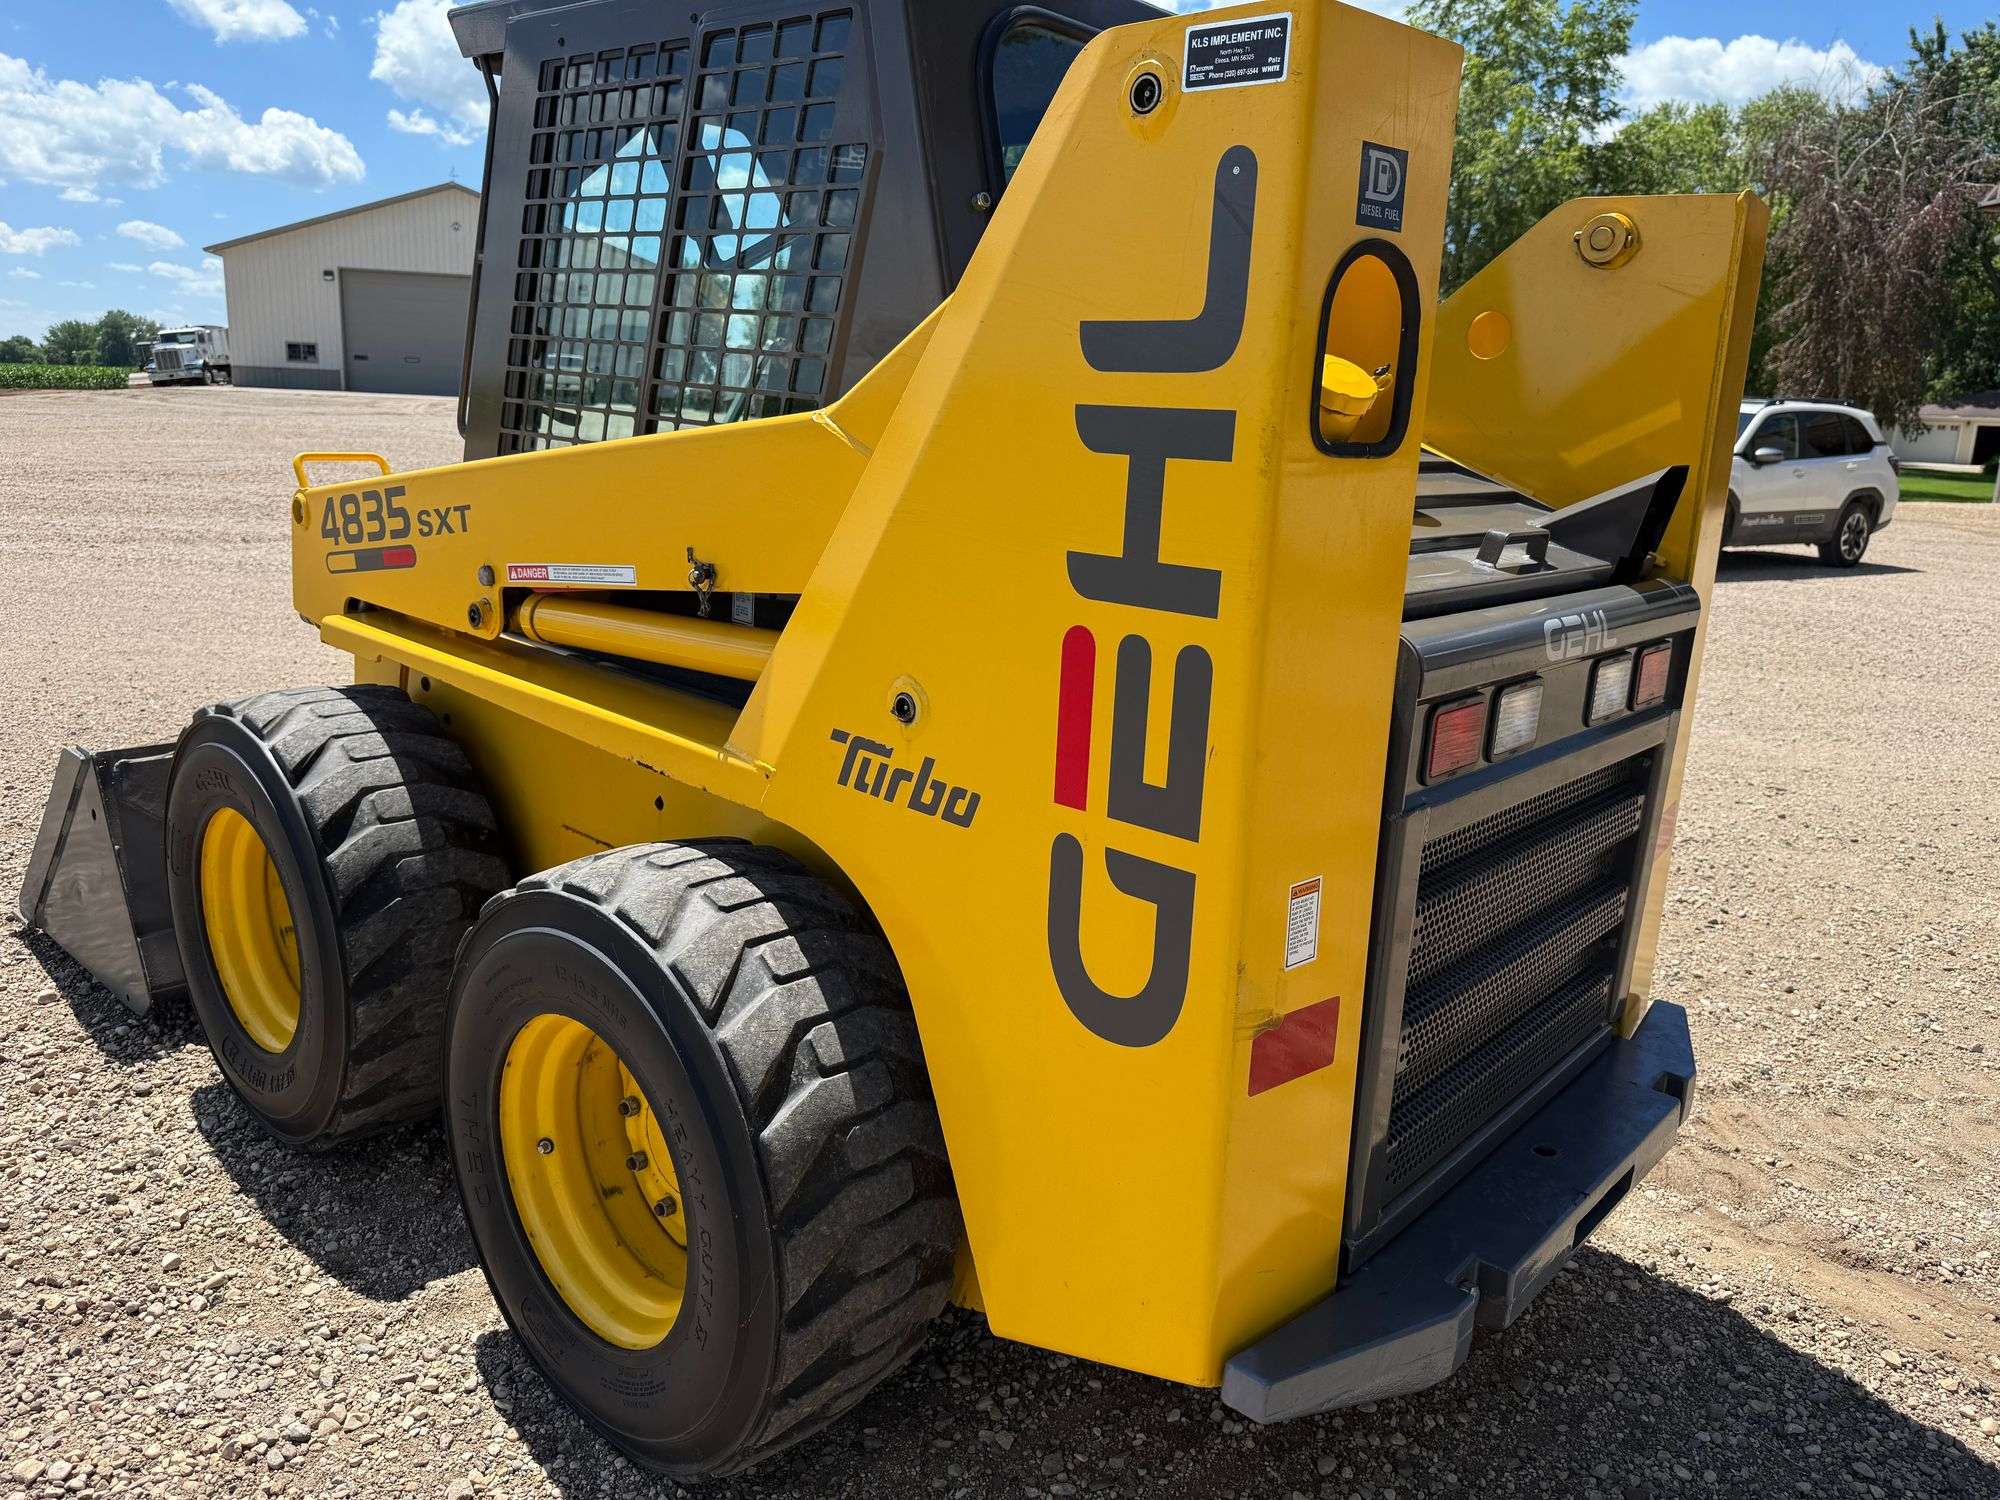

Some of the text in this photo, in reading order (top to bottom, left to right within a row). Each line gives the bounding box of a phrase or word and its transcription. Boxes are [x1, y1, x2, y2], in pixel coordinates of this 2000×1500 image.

[1192, 27, 1284, 49] KLS IMPLEMENT INC.
[1261, 65, 1281, 73] WHITE
[1360, 203, 1400, 221] DIESEL FUEL
[320, 485, 472, 546] 4835 SXT
[517, 568, 548, 579] DANGER
[1048, 144, 1258, 1048] GEHL
[1543, 609, 1618, 662] GEHL
[830, 728, 982, 828] Turbo
